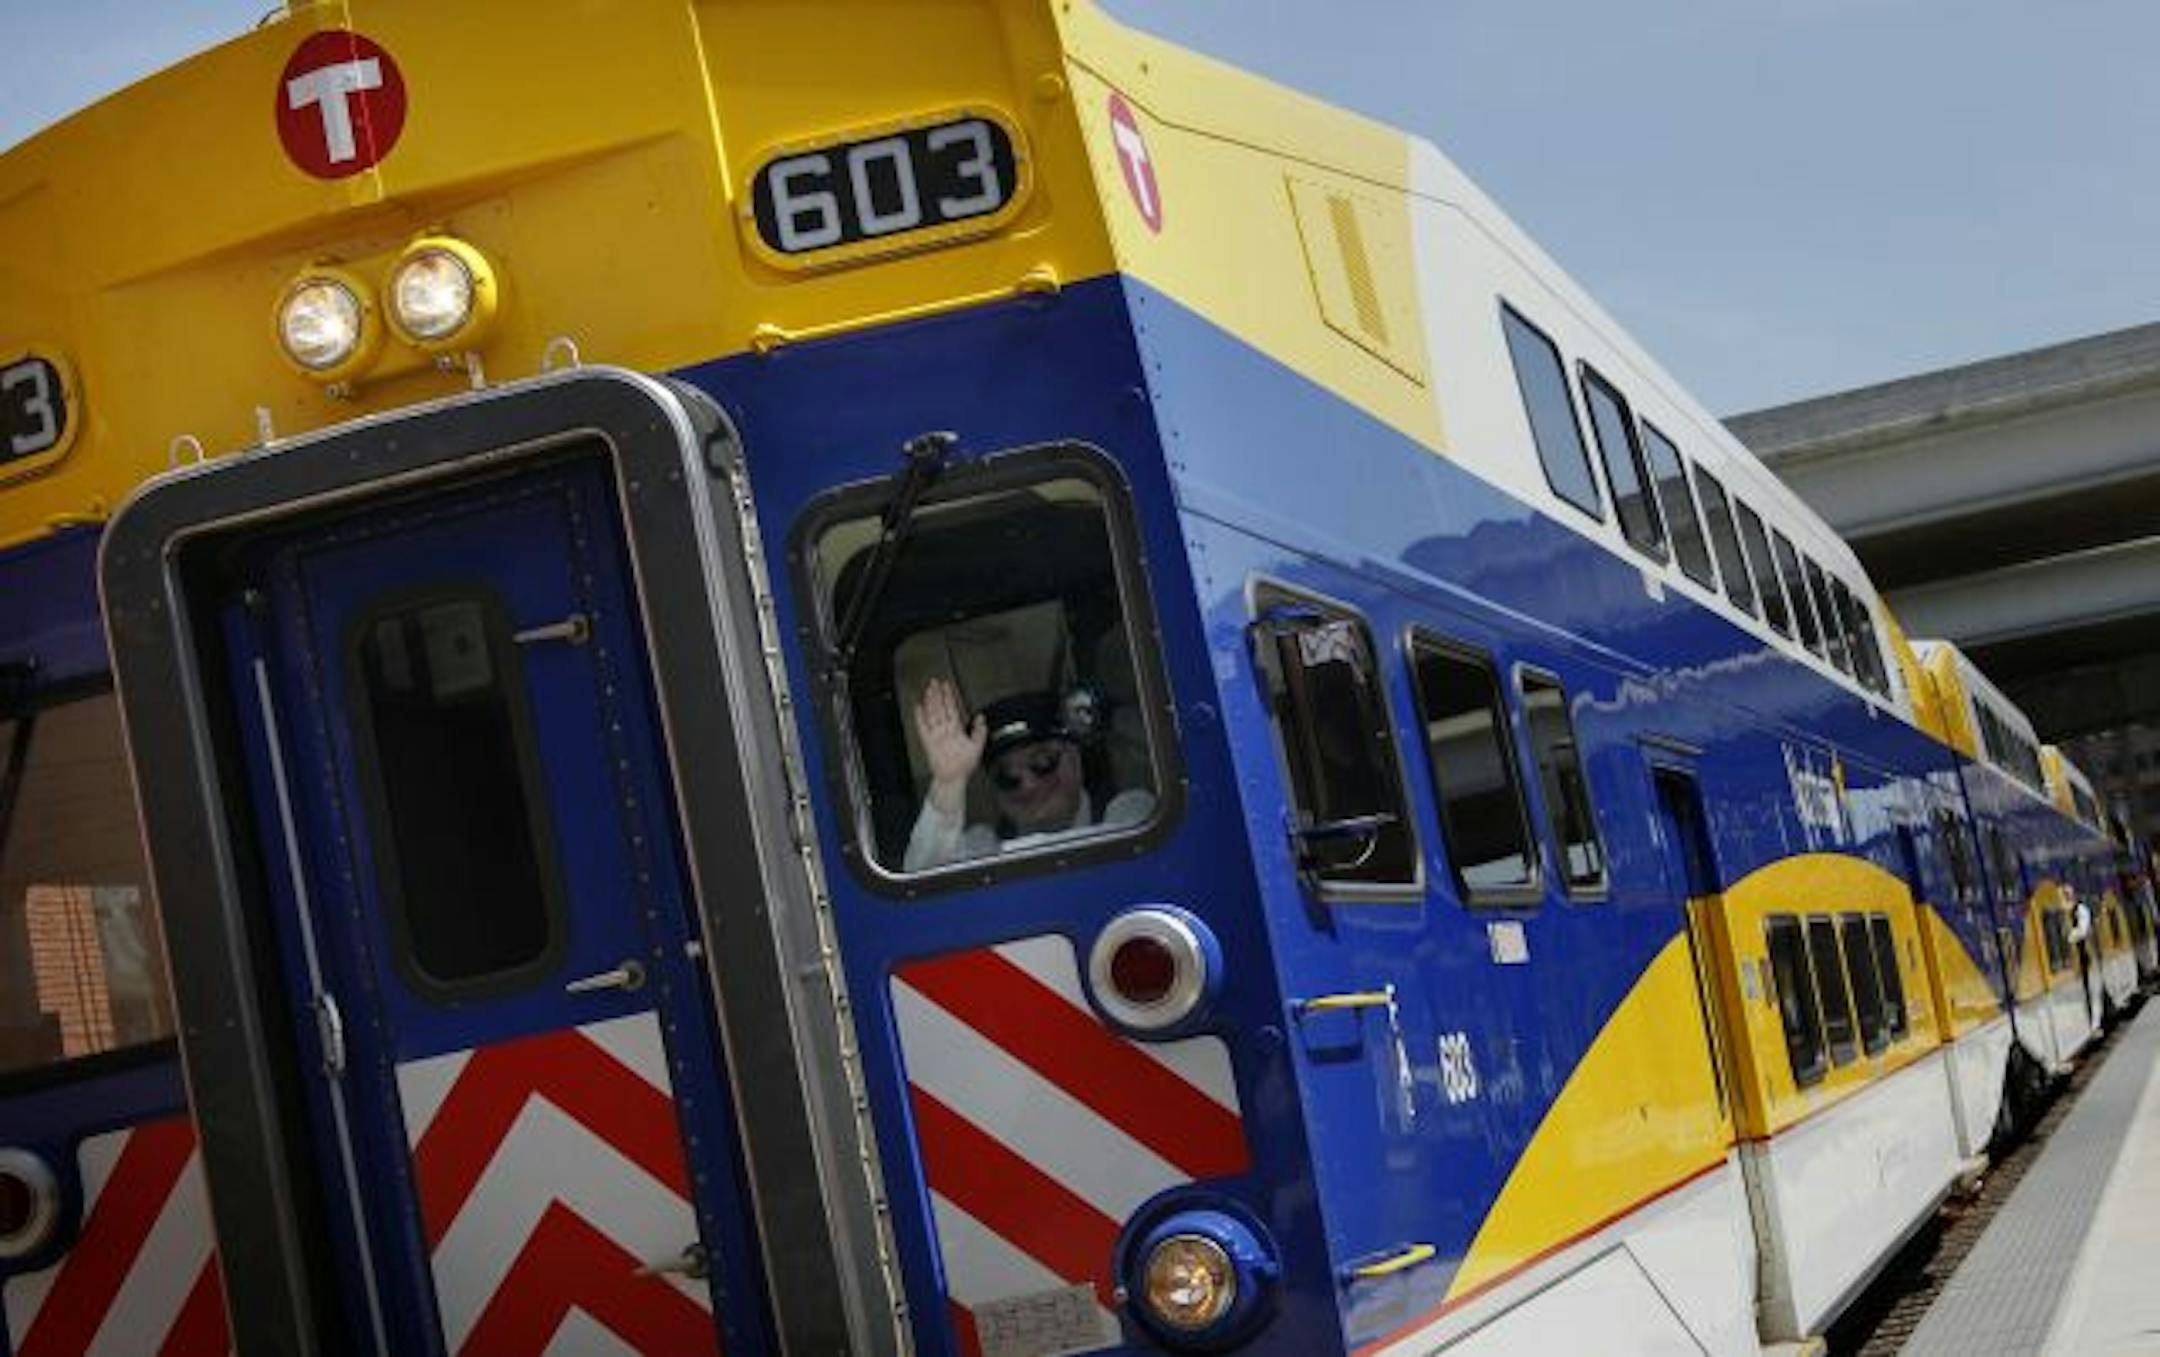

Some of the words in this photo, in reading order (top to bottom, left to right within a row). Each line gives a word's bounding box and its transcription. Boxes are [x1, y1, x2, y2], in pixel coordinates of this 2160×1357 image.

[287, 56, 384, 164] T
[768, 119, 1001, 253] 603
[1112, 120, 1155, 217] T
[1, 361, 57, 454] 3
